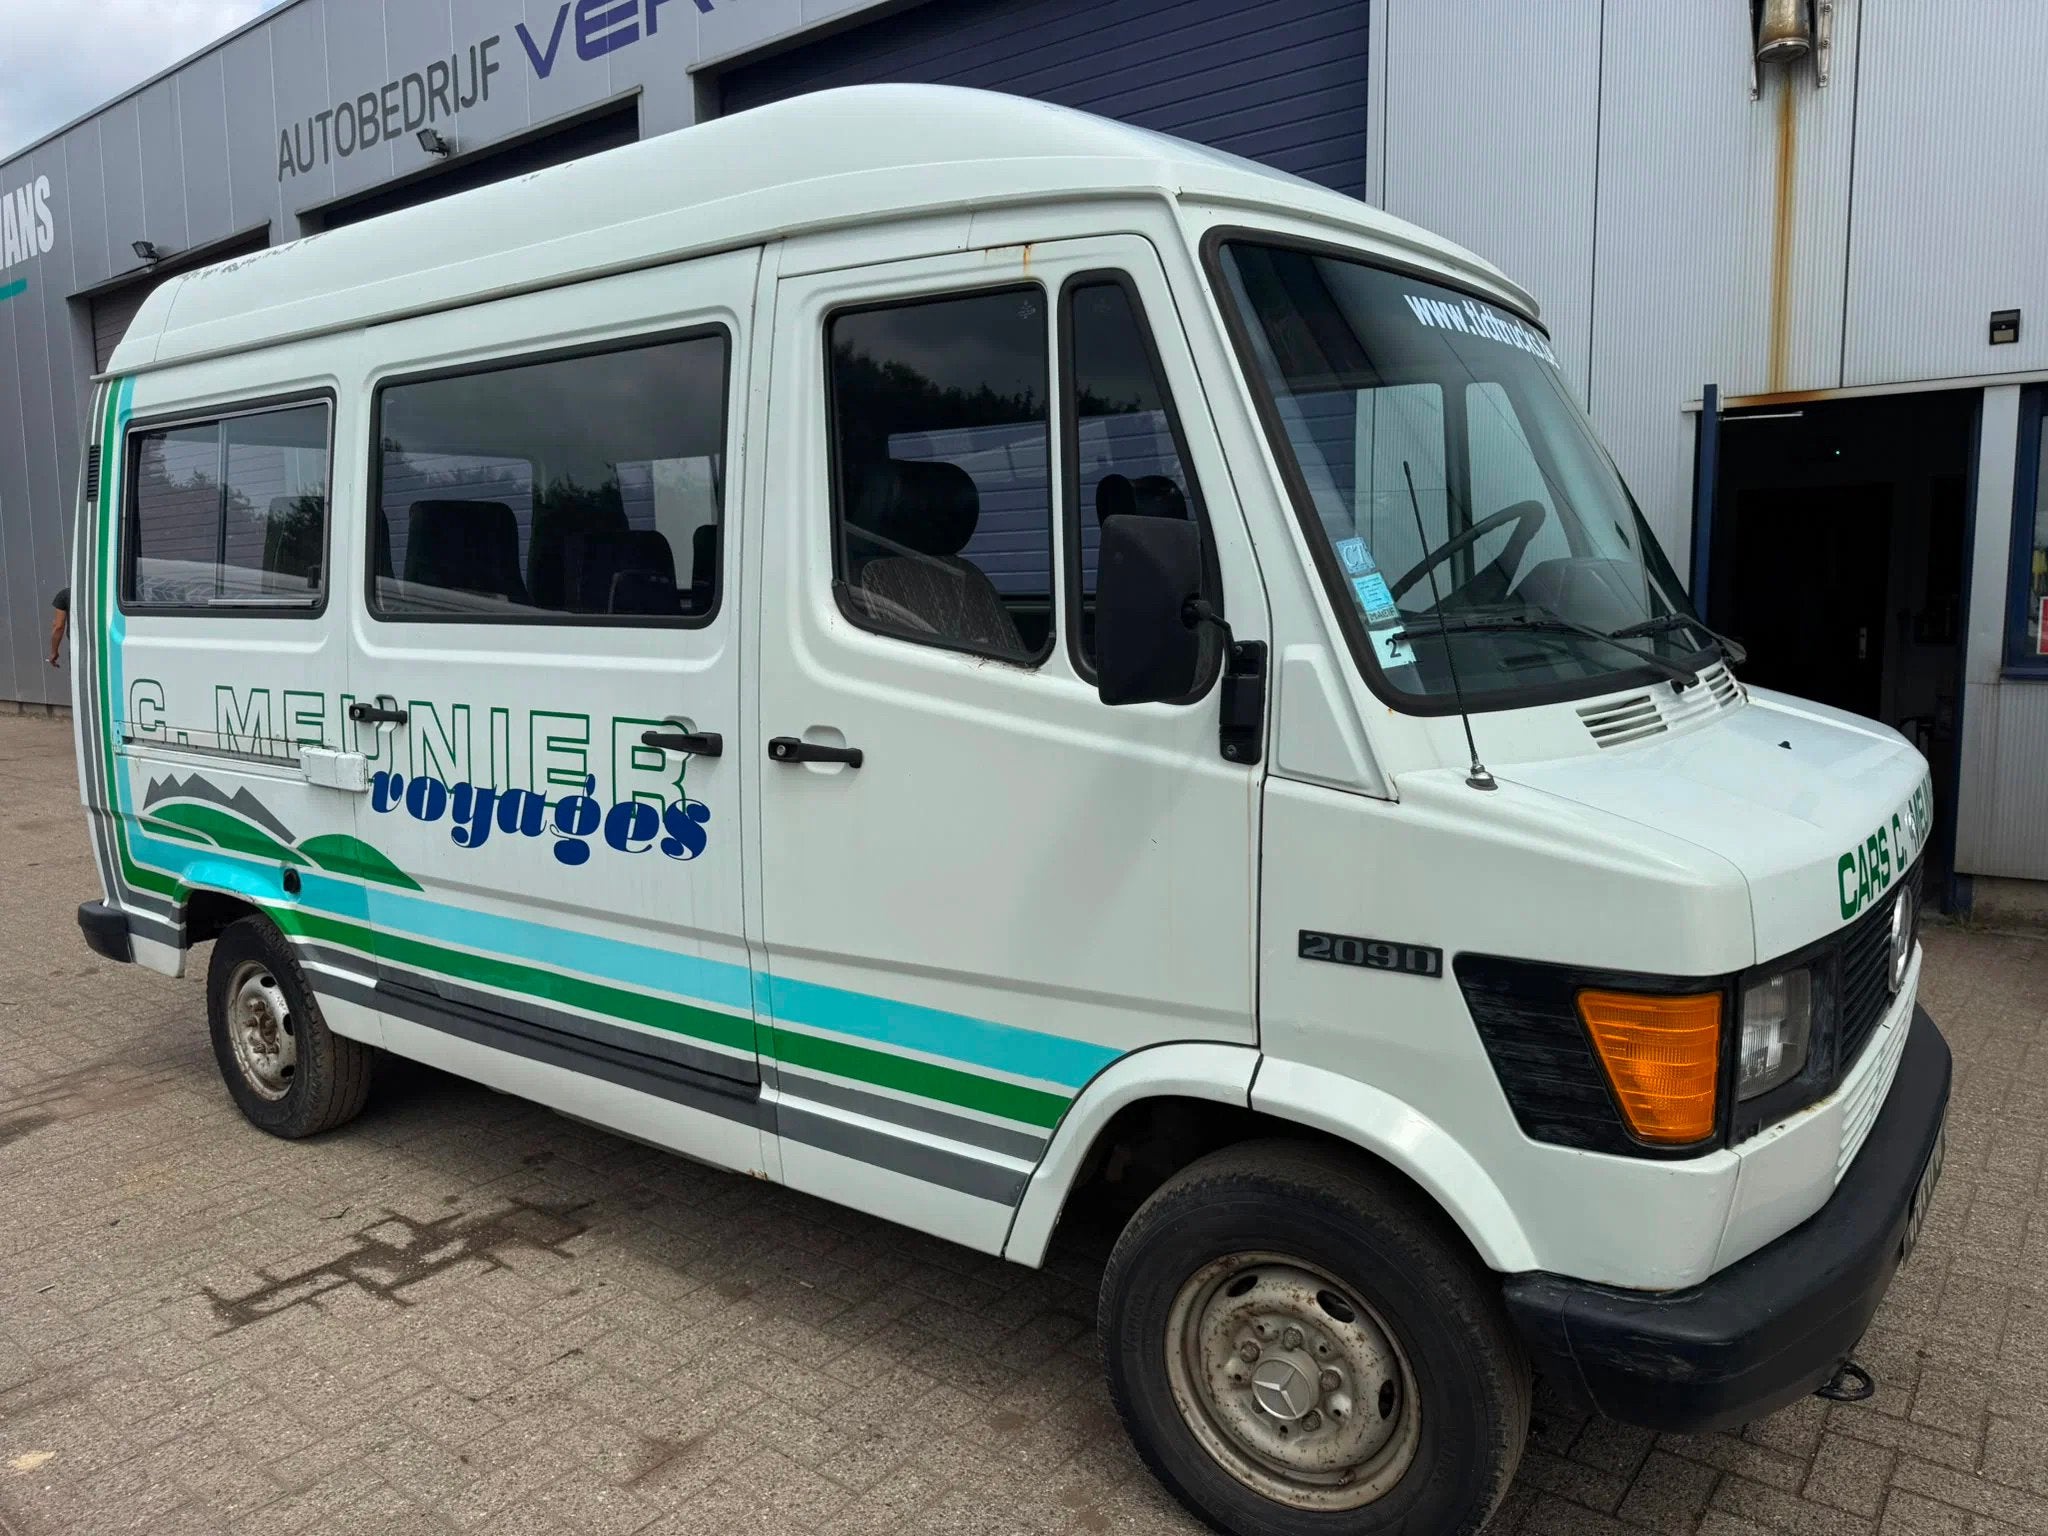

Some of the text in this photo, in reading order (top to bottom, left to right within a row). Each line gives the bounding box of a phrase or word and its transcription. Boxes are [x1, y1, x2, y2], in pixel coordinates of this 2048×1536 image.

[277, 35, 500, 183] AUTOBEDRIJF
[0, 174, 54, 272] ANS
[1385, 637, 1402, 659] 2
[215, 684, 693, 824] MEUNIER
[371, 770, 712, 867] voyages
[1837, 825, 1891, 921] CARS
[1891, 813, 1908, 873] C.
